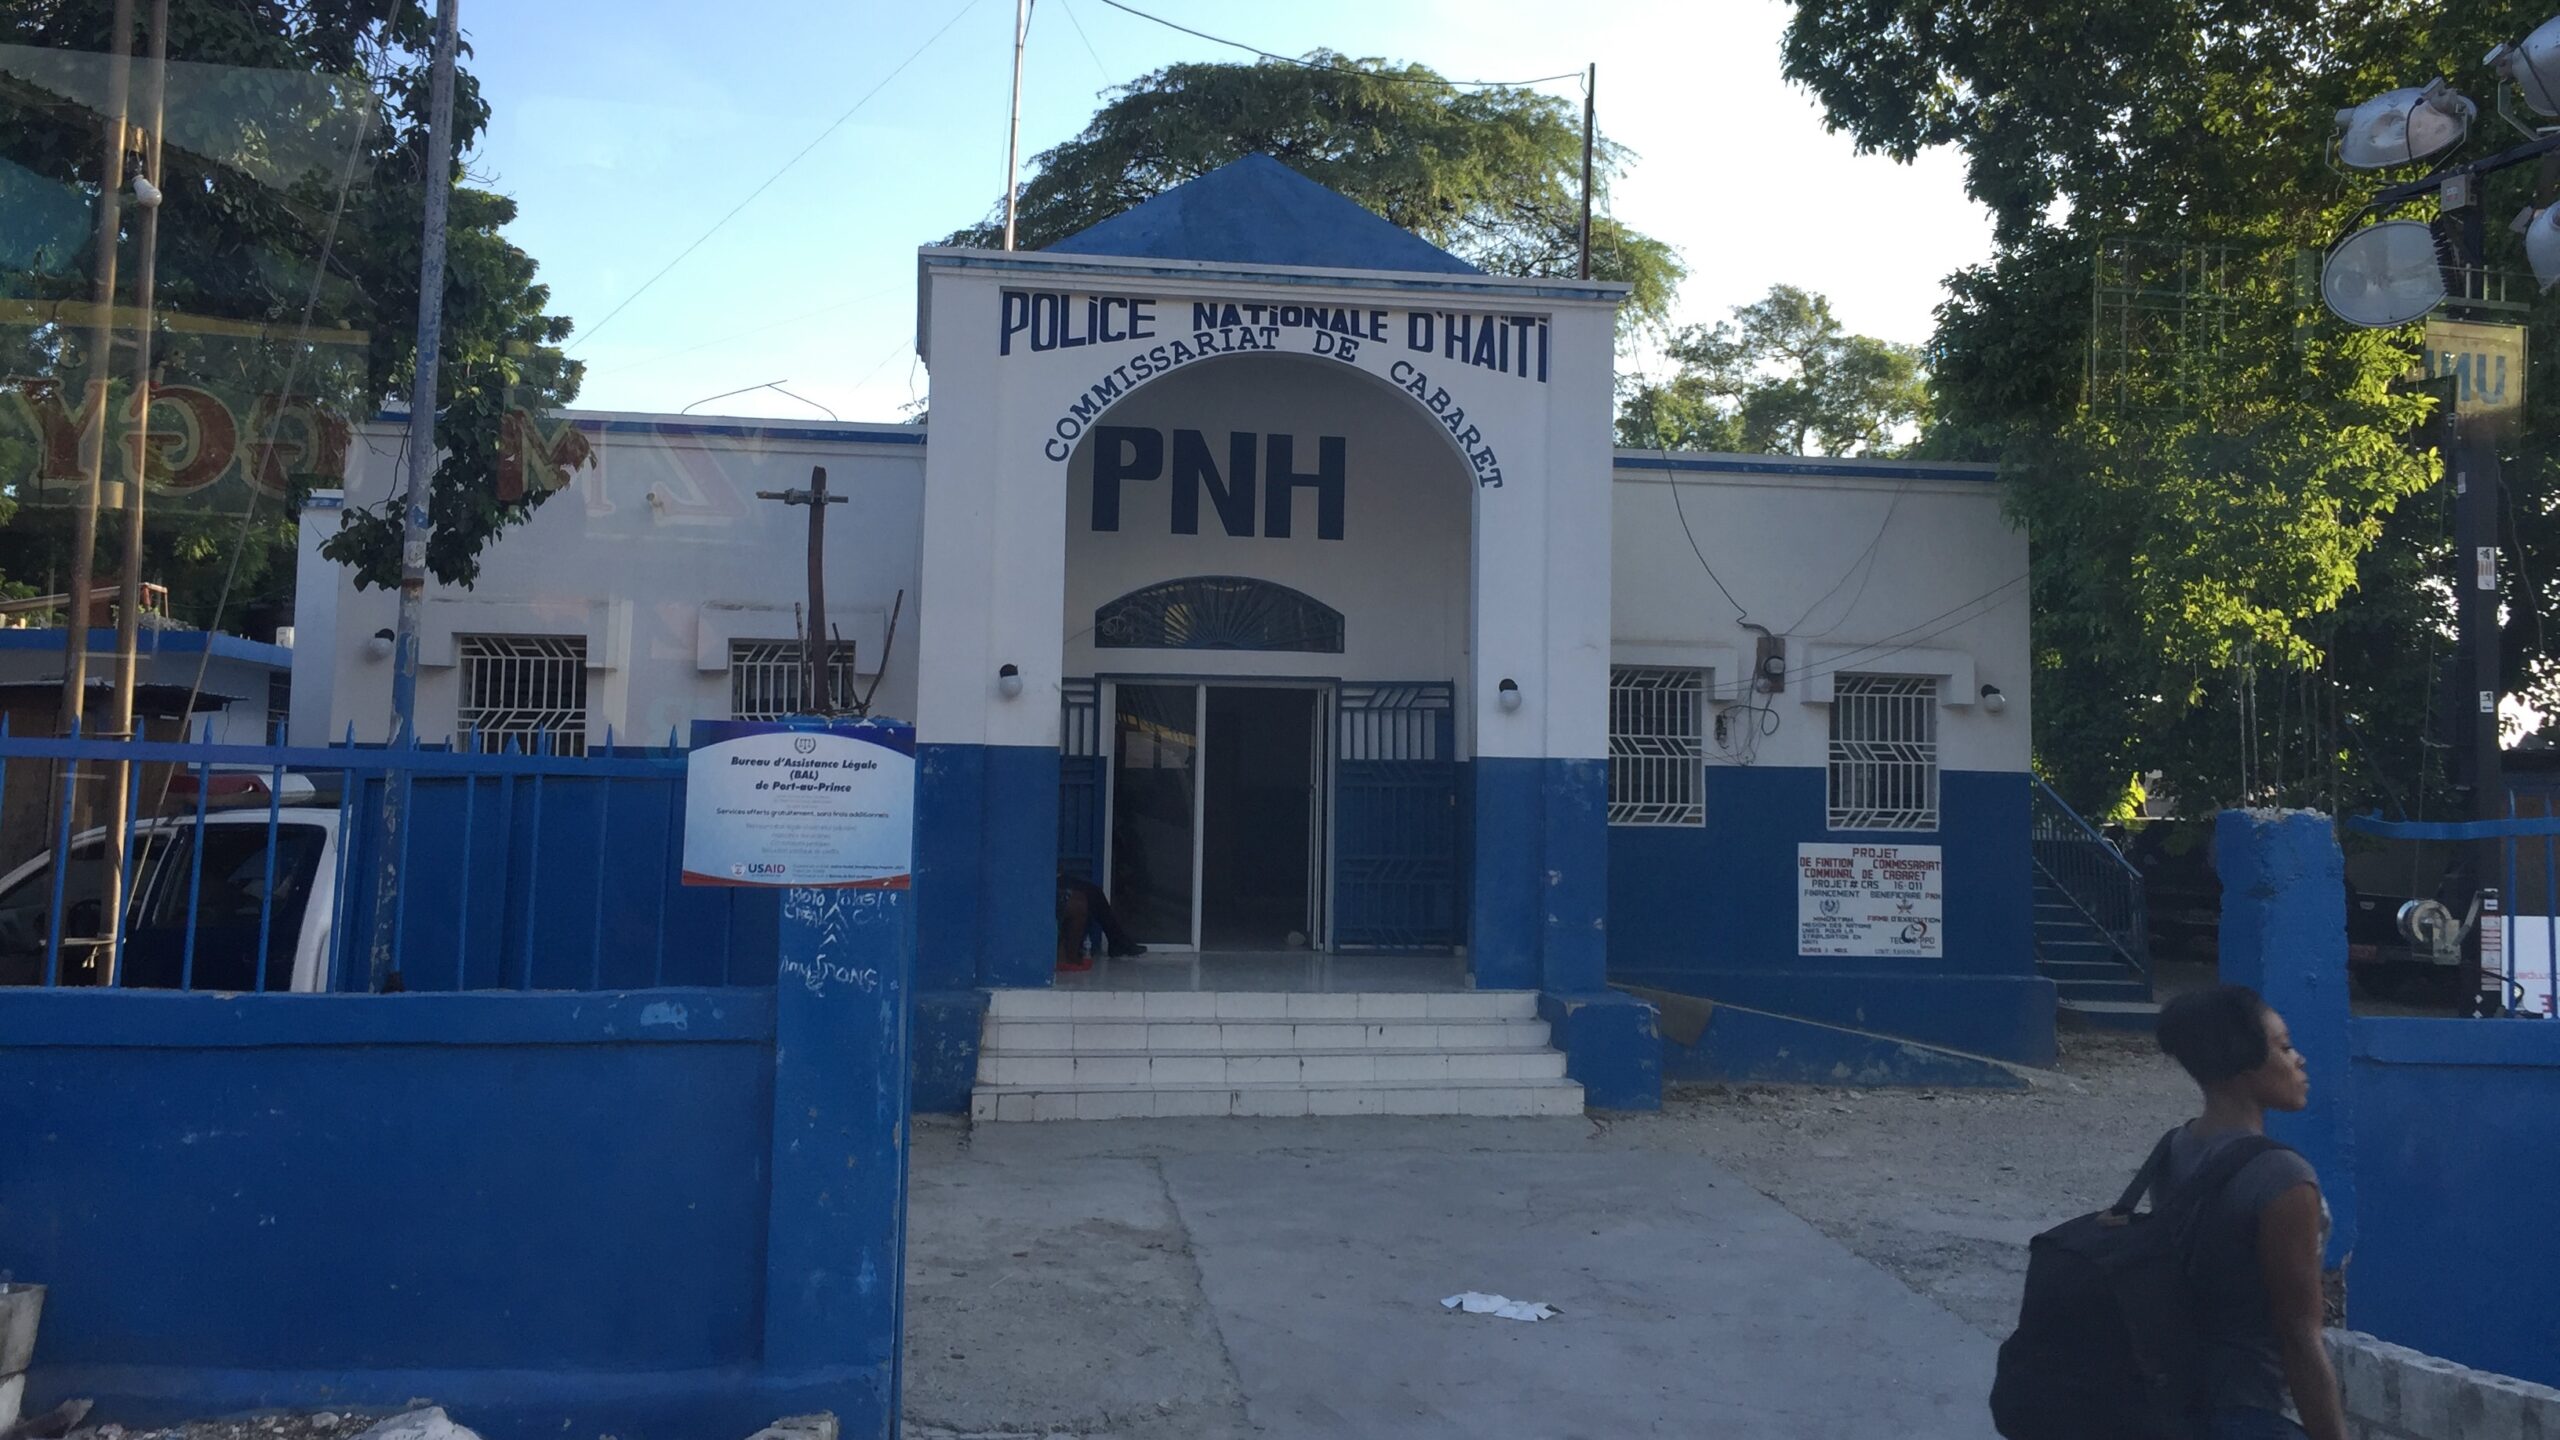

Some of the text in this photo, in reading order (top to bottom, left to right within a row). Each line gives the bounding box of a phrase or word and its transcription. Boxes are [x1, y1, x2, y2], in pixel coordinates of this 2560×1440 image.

[1045, 327, 1502, 488] COMMISSARIAT DE CABARET
[1092, 426, 1346, 540] PNH
[731, 756, 877, 771] Bureau d'Assistance Légale
[790, 770, 819, 780] (BAL)
[755, 780, 852, 792] de Port-au-Prince
[1852, 848, 1898, 858] PROJET
[748, 863, 785, 873] USAID
[1800, 857, 1811, 867] DE
[1816, 858, 1853, 868] FINITION
[1804, 868, 1926, 881] COMMUNAL DE CABARET
[1812, 879, 1848, 888] PROJET
[1861, 880, 1879, 889] CAS
[1804, 889, 1860, 898] FINANCEMENT
